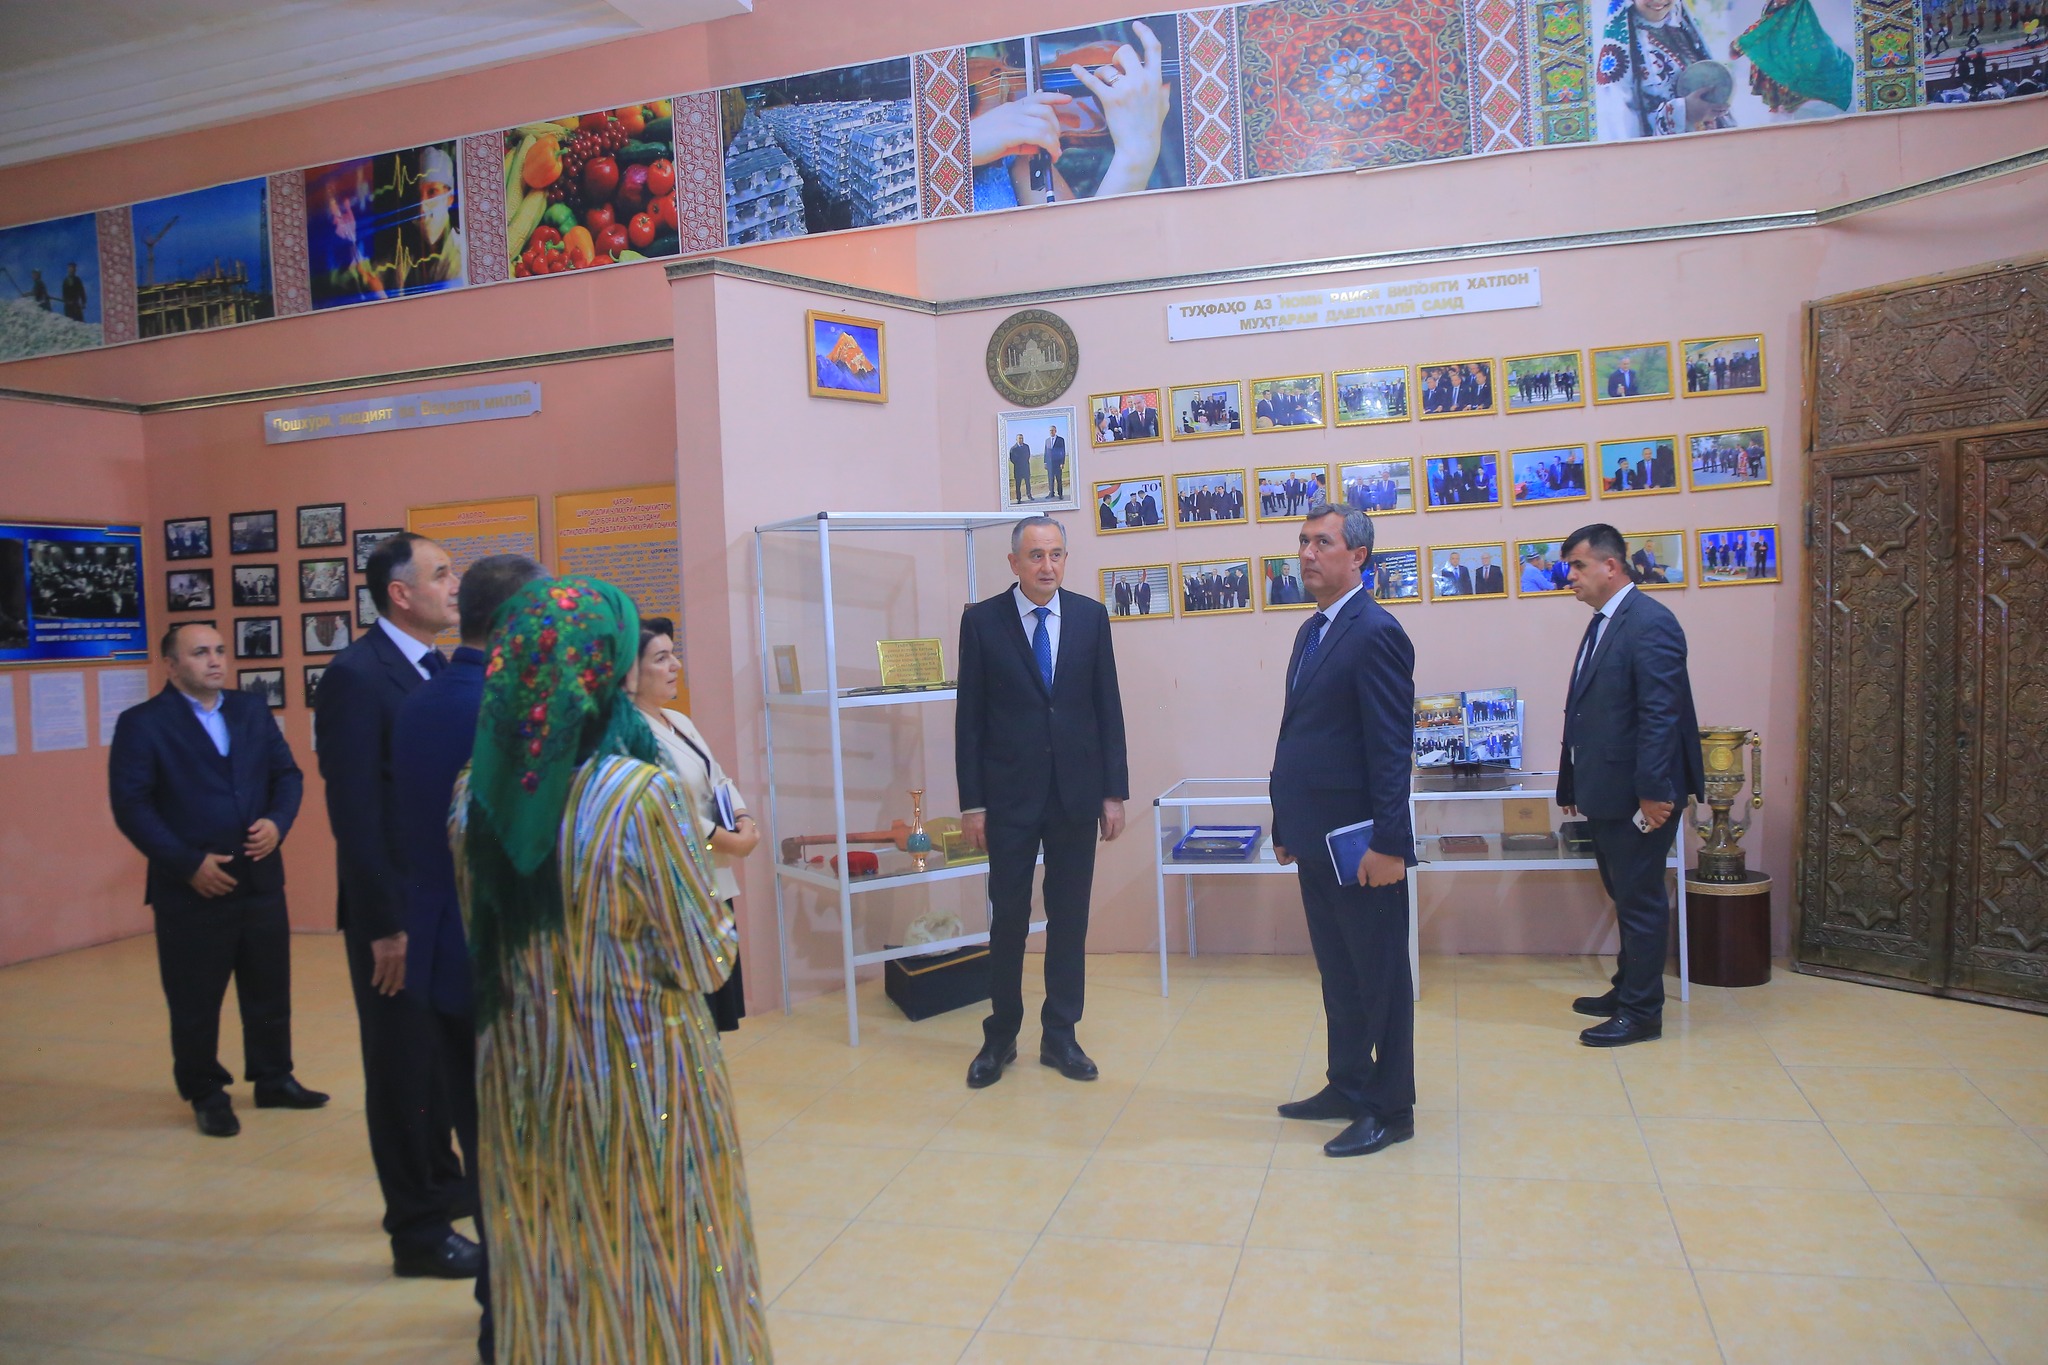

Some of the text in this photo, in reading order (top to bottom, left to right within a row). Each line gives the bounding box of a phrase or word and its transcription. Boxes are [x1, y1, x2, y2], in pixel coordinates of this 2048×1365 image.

[1180, 301, 1246, 318] ТУҲФАҲО
[1254, 298, 1272, 311] АЗ
[1330, 288, 1379, 304] РАИСИ
[1388, 280, 1459, 299] ВИЛОЯТИ
[1467, 273, 1529, 290] ХАТЛОН
[1240, 312, 1318, 331] МУҲТАРАМ
[1422, 297, 1465, 312] САИД
[1142, 482, 1162, 493] ТО
